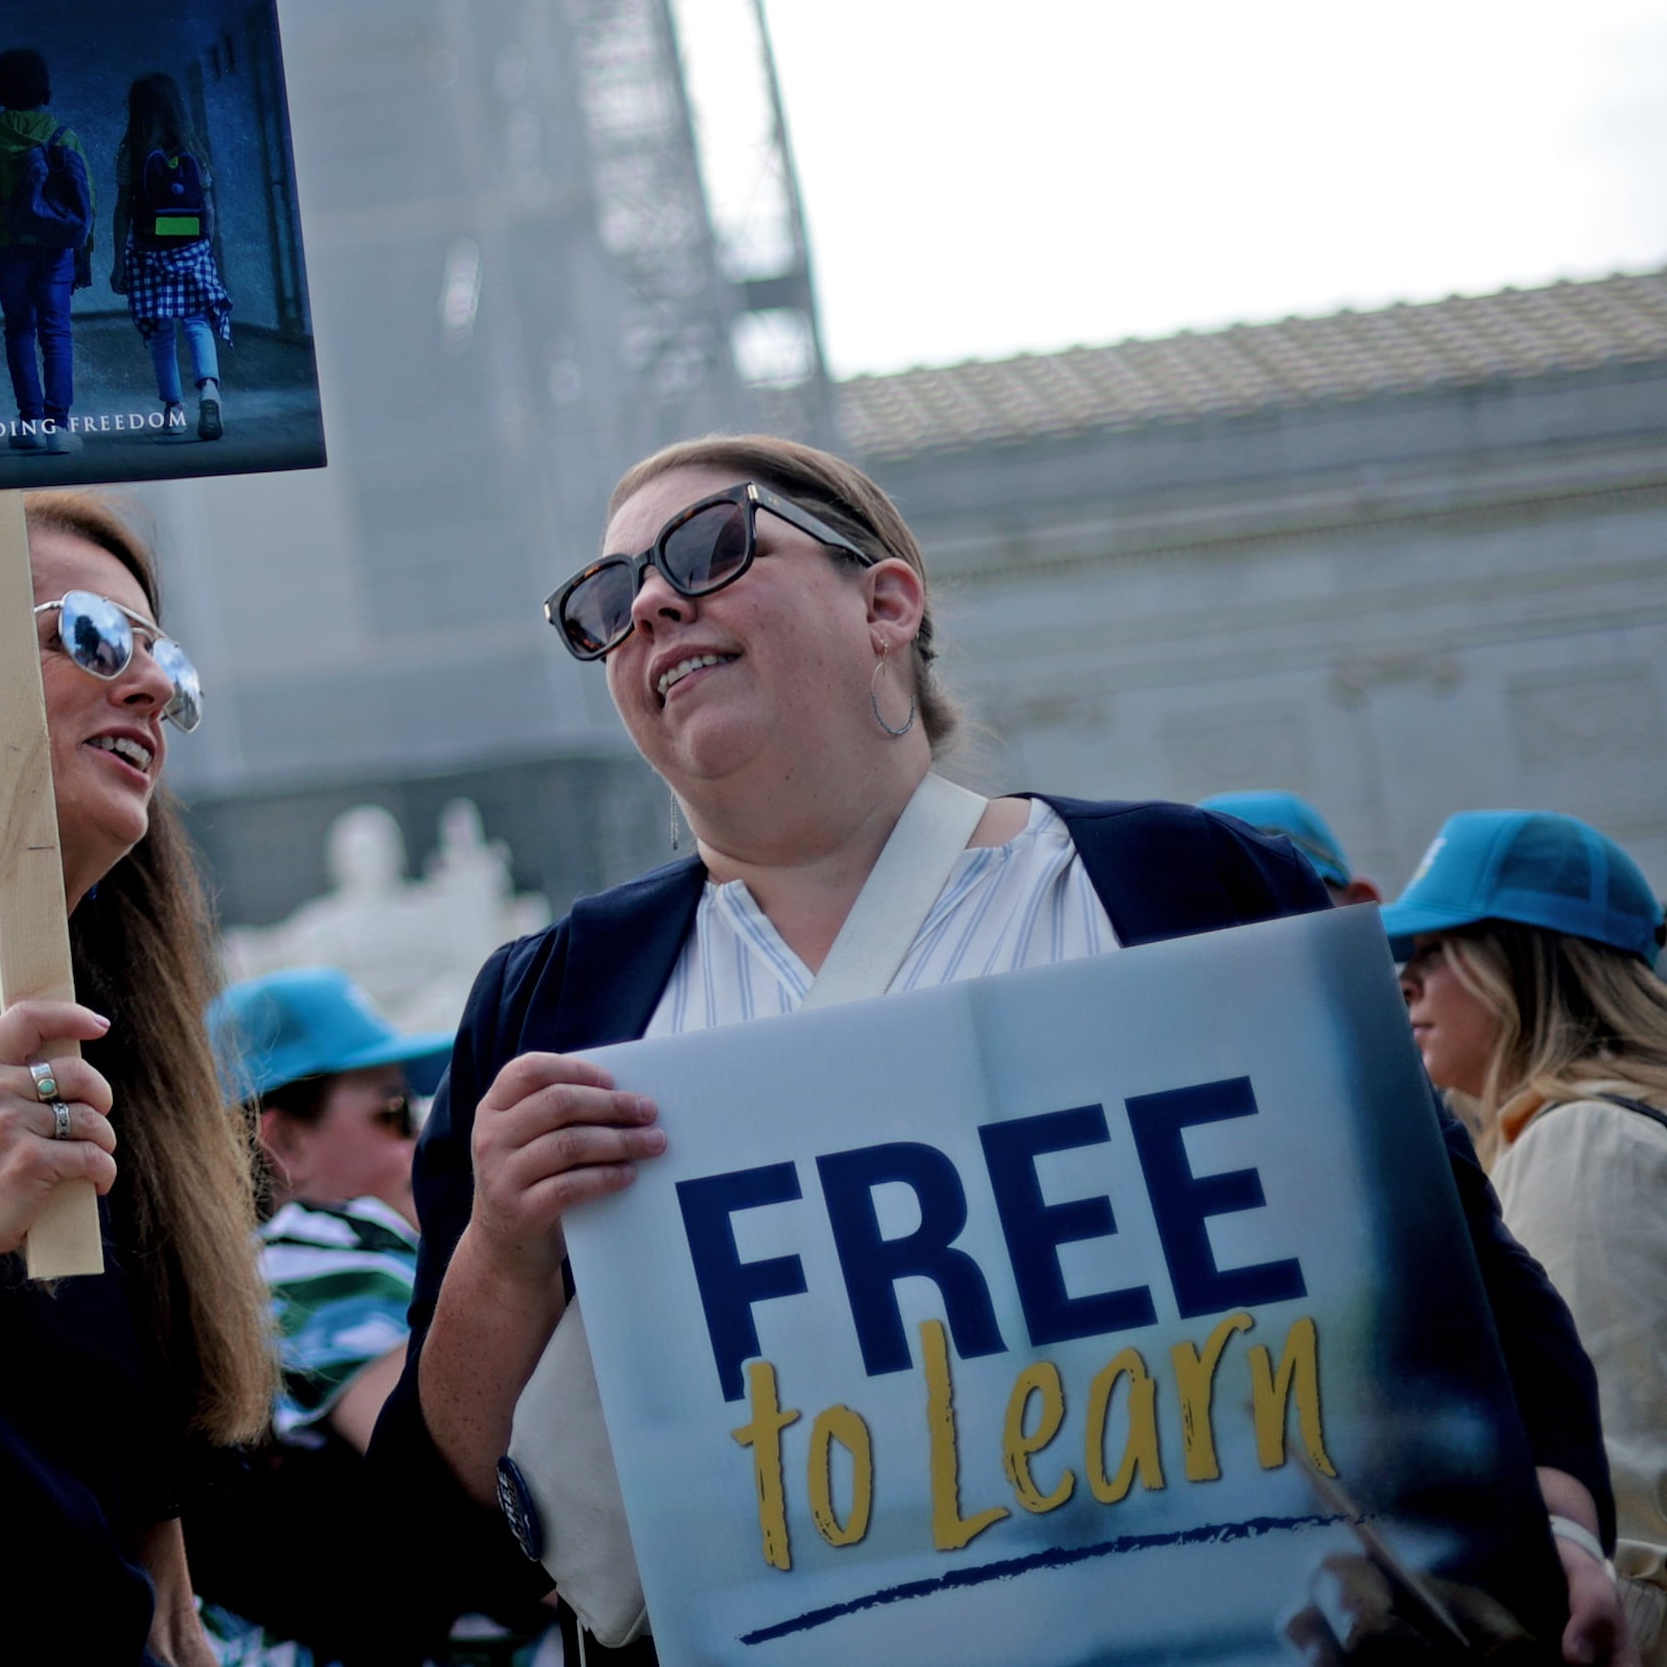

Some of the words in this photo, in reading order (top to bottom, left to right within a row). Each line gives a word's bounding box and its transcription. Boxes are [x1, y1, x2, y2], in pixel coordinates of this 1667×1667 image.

[69, 410, 188, 433] FREEDOM
[675, 1075, 1308, 1402] FREE
[731, 1360, 873, 1572] to
[919, 1312, 1336, 1552] Learn
